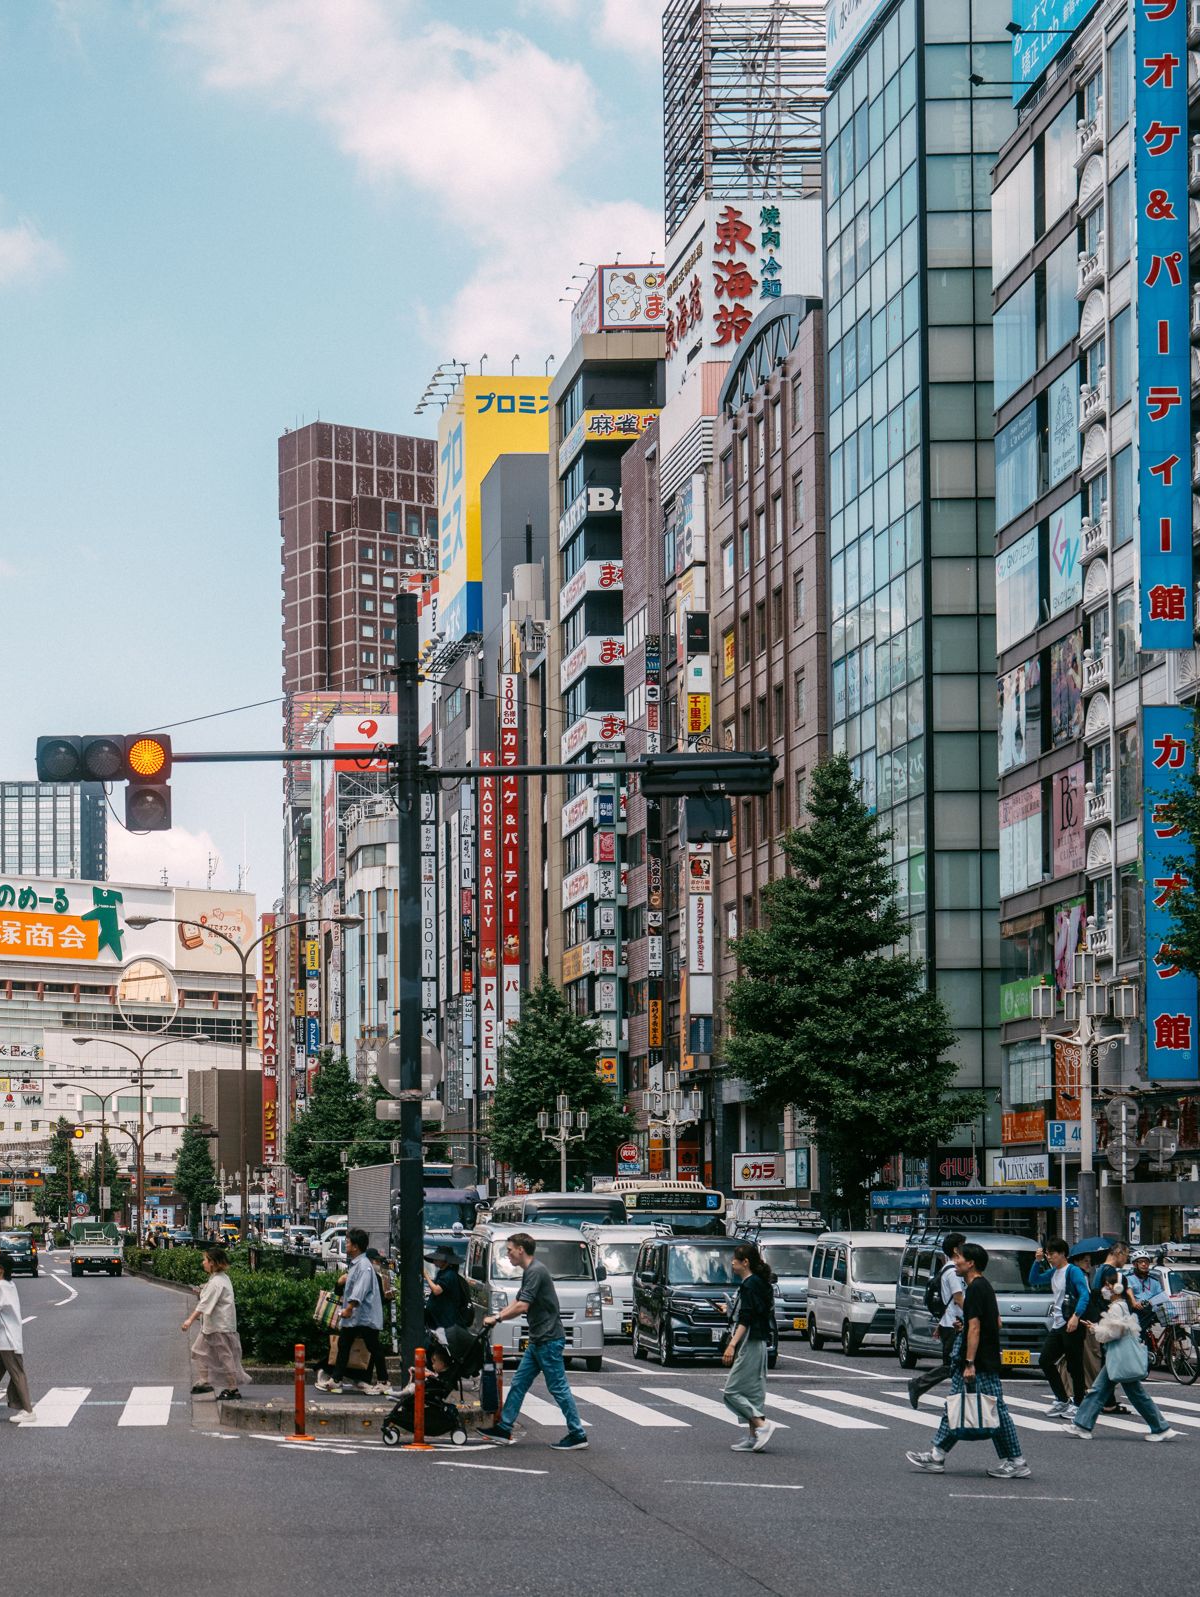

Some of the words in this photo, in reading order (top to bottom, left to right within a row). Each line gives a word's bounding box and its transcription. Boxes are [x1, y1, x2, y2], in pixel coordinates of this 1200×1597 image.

[759, 204, 784, 300] 焼肉・冷麺
[710, 204, 758, 348] 東海苑
[558, 496, 586, 542] DARTS
[504, 677, 514, 710] 300
[689, 695, 702, 733] 千里香
[503, 717, 517, 725] OK
[483, 752, 493, 841] KRAOKE
[484, 848, 494, 858] &
[484, 866, 494, 928] PARTY
[263, 925, 275, 975] パチンコ
[424, 886, 434, 974] KIBORI
[308, 942, 317, 969] プロミス
[263, 979, 276, 1050] エスパス
[483, 982, 495, 1087] PASELA
[264, 1101, 276, 1141] パチンコ
[1054, 1124, 1063, 1138] P
[942, 1197, 988, 1206] SUBNADE
[1008, 1355, 1029, 1364] 31-26
